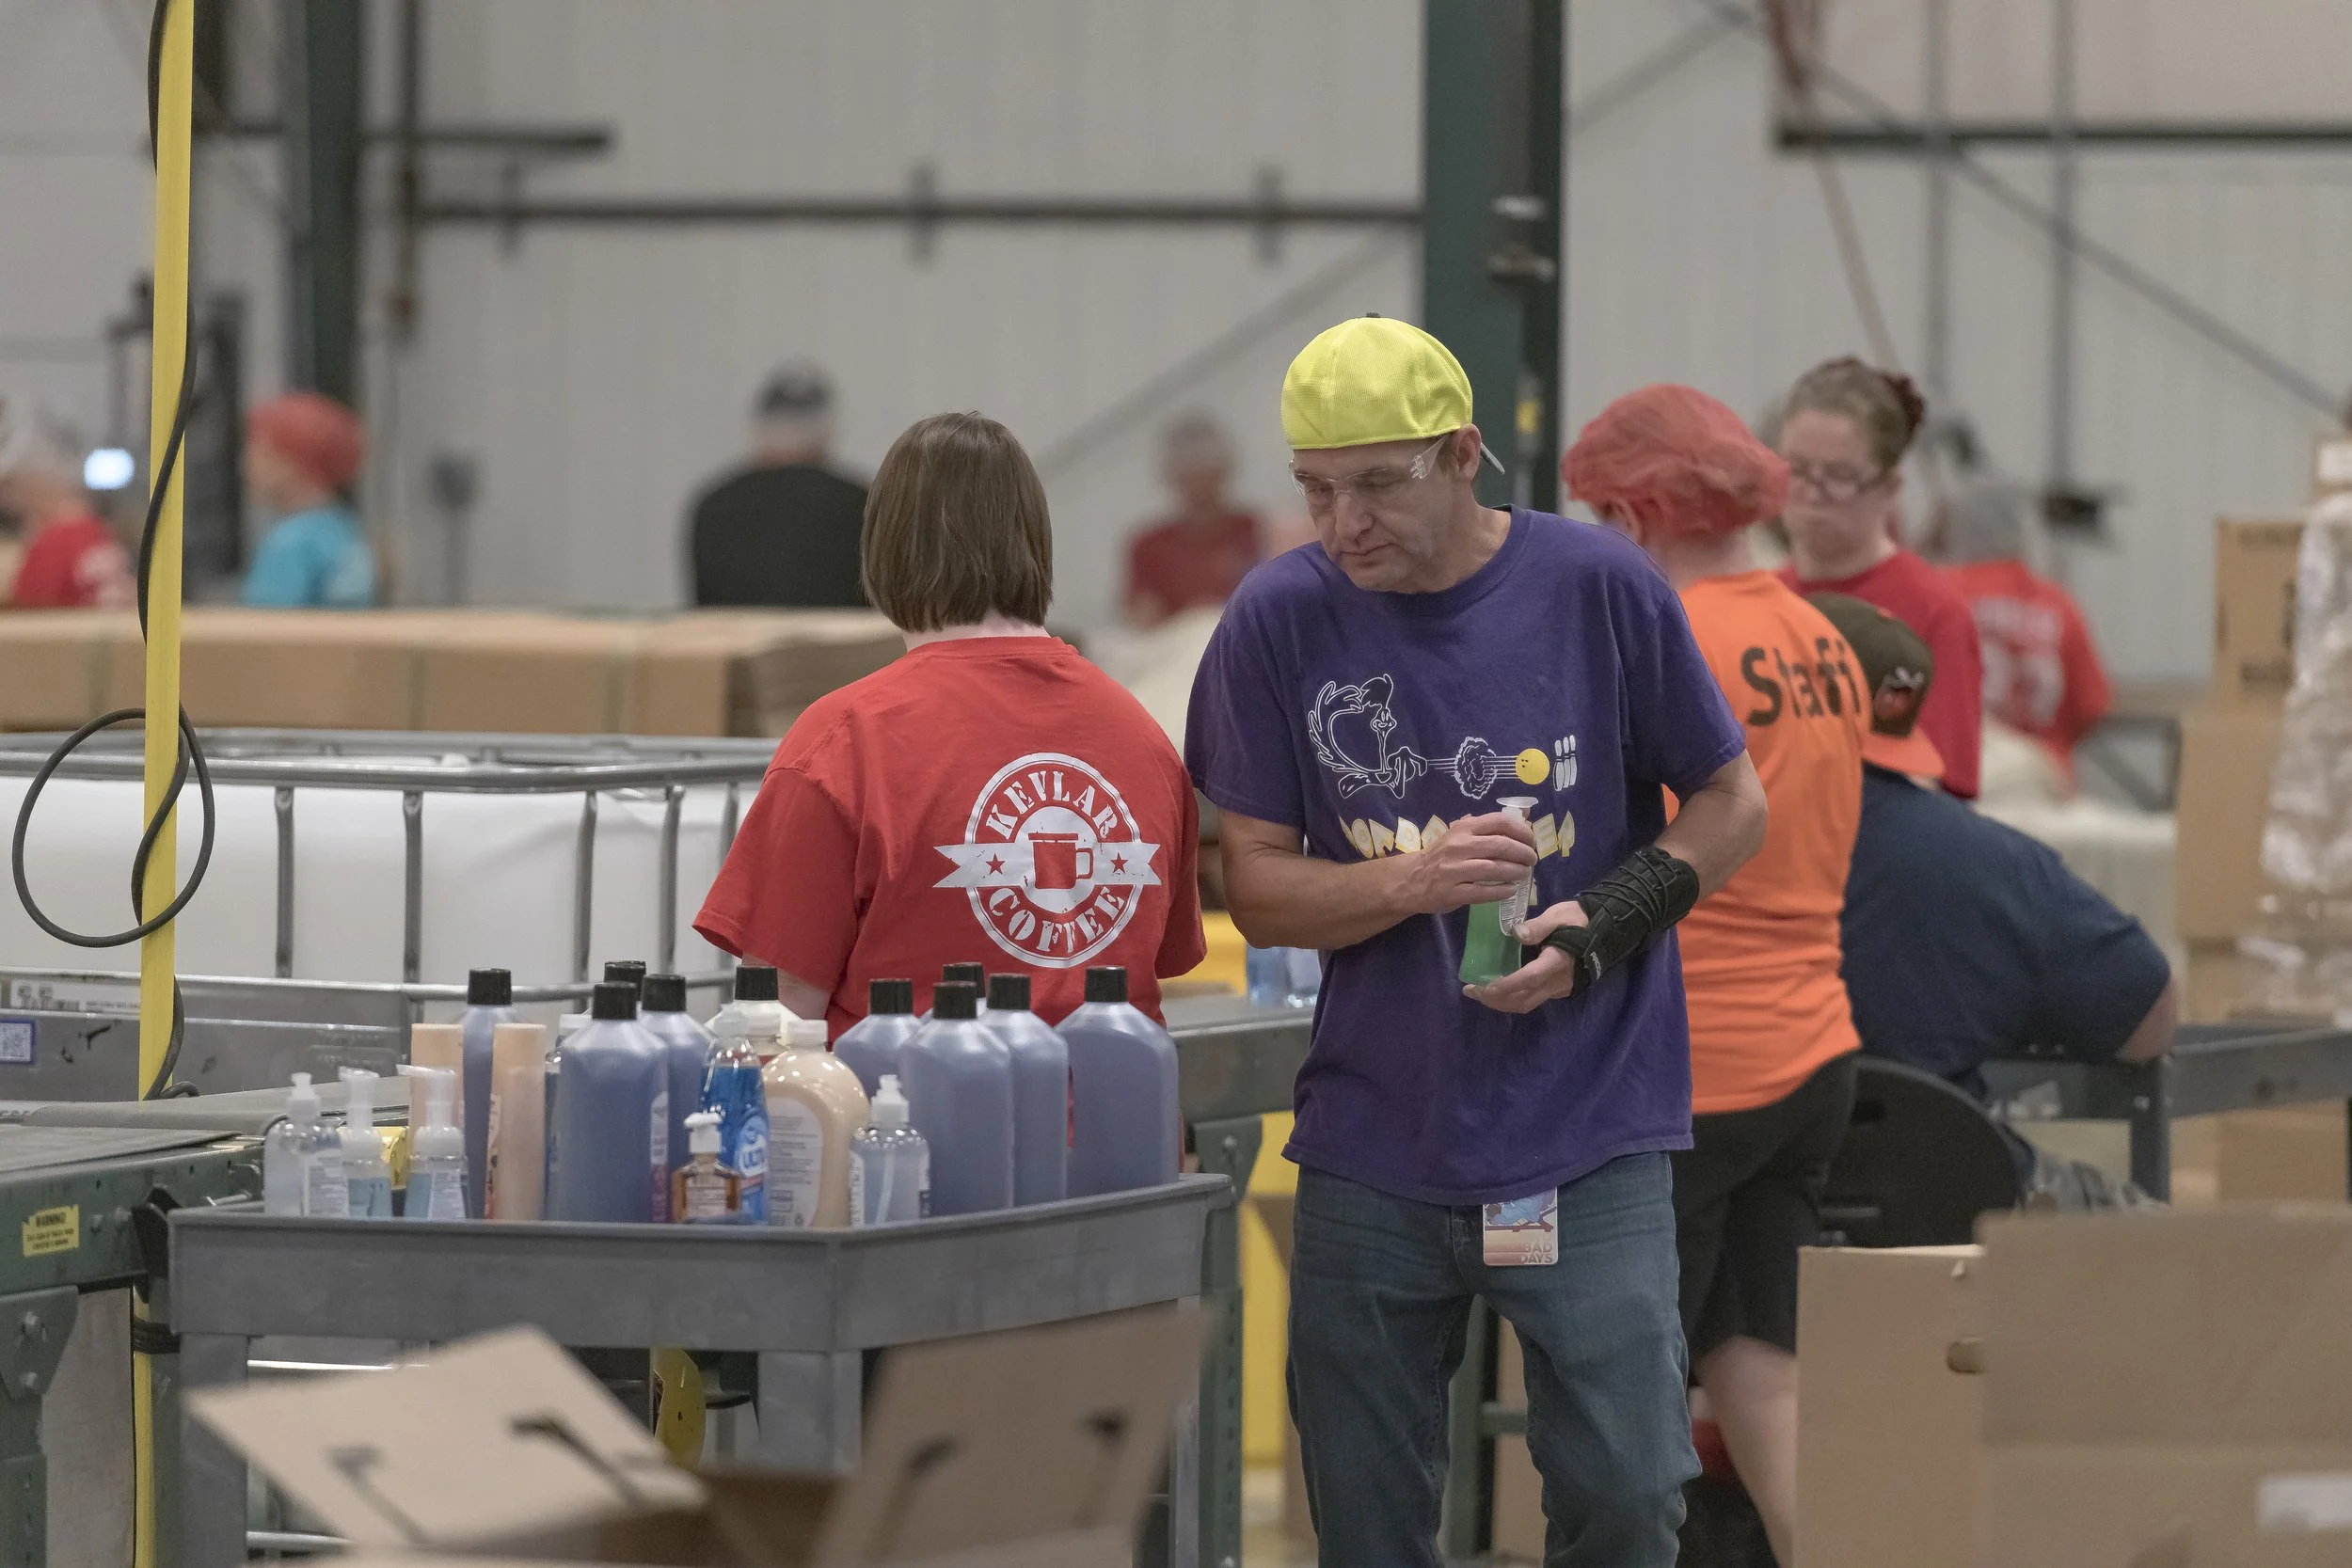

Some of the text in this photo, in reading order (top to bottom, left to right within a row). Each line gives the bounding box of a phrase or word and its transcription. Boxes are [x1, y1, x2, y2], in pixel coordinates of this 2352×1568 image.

[1741, 638, 1861, 727] Staff
[986, 770, 1119, 840] KEVLAR
[989, 886, 1125, 954] COFFEE
[1519, 1253, 1553, 1263] DAYS
[1523, 1242, 1553, 1253] BAD
